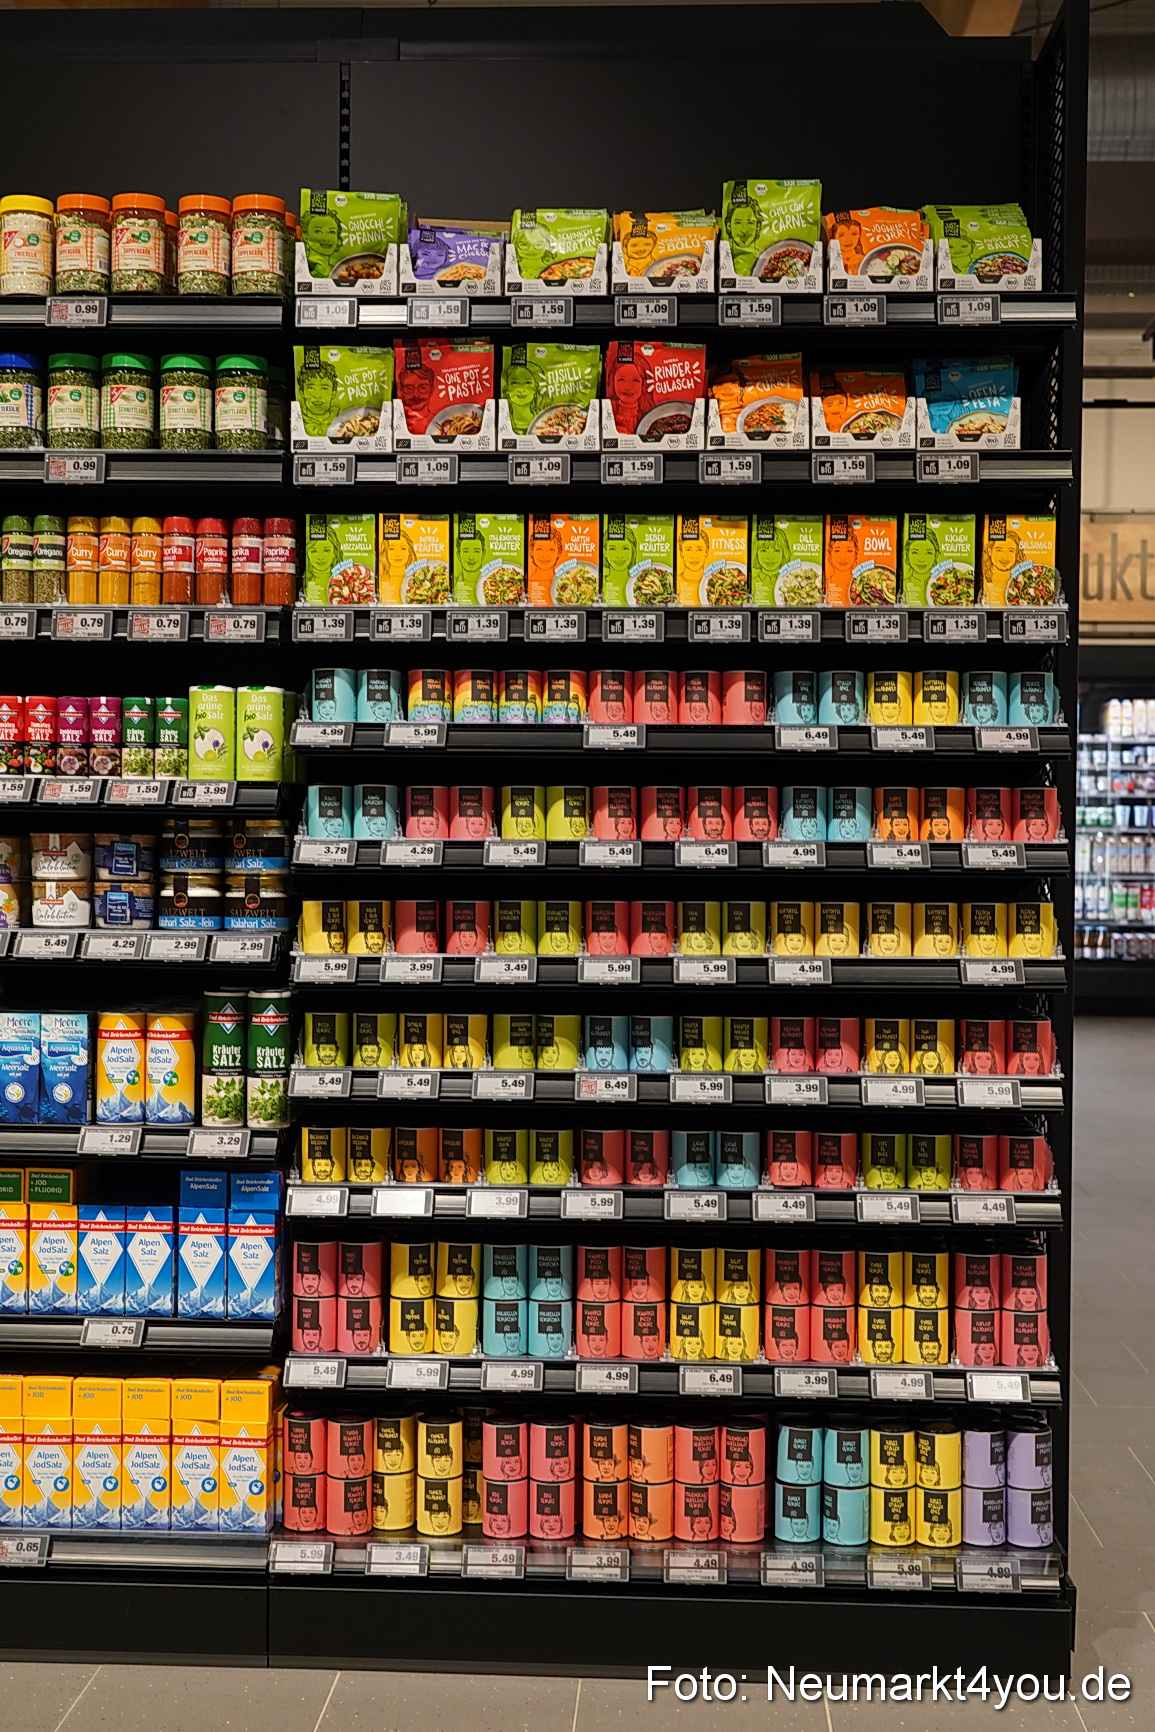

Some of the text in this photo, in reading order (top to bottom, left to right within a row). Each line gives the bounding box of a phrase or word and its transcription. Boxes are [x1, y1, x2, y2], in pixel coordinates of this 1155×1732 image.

[769, 202, 804, 217] CHILI CON
[348, 218, 384, 232] GNOCCHI
[772, 213, 806, 233] CARNE
[871, 221, 908, 233] JOGHURT
[349, 229, 386, 247] PFANNE
[558, 229, 593, 241] SCHINKEN
[877, 229, 911, 243] CURRY
[456, 243, 476, 253] MAC
[559, 238, 596, 253] GRATIN
[667, 239, 700, 250] BOLO
[987, 241, 1021, 250] SALAT
[75, 305, 98, 314] 0.99
[438, 305, 460, 315] 1.59
[645, 304, 668, 314] 1.09
[749, 304, 772, 313] 1.59
[854, 303, 877, 313] 1.09
[968, 302, 991, 312] 1.09
[654, 361, 691, 379] RINDER
[344, 370, 377, 385] ONE POT
[445, 370, 479, 385] ONE POT
[547, 367, 581, 384] FUSILLI
[655, 378, 695, 394] GULASCH
[757, 376, 791, 391] CURRY
[347, 384, 380, 401] PASTA
[448, 383, 482, 401] PASTA
[548, 382, 585, 398] PFANNE
[864, 398, 891, 409] CURRY
[972, 397, 1000, 408] FETA
[73, 461, 96, 471] 0.99
[324, 462, 346, 472] 1.59
[538, 462, 561, 471] 1.09
[631, 462, 654, 471] 1.59
[729, 461, 752, 471] 1.59
[344, 534, 367, 542] TOMATE
[570, 535, 590, 543] GARTEN
[644, 534, 666, 542] SIEBEN
[799, 534, 813, 544] DILL
[414, 543, 444, 552] KRÄUTER
[489, 541, 521, 551] KRÄUTER
[565, 542, 596, 552] KRÄUTER
[639, 542, 670, 552] KRÄUTER
[712, 537, 745, 550] FITNESS
[793, 542, 820, 551] KRÄUTER
[864, 536, 892, 552] BOWL
[942, 542, 971, 552] KRÄUTER
[1018, 538, 1053, 550] BALSAMICO
[37, 548, 63, 558] Oregano
[72, 546, 93, 560] Curry
[135, 546, 157, 560] Curry
[5, 617, 28, 627] 0.79
[157, 619, 180, 629] 0.79
[233, 620, 256, 630] 0.79
[322, 619, 345, 629] 1.39
[632, 619, 655, 629] 1.39
[719, 620, 741, 630] 1.39
[876, 620, 899, 629] 1.39
[202, 694, 217, 702] Das
[251, 694, 267, 702] Das
[198, 702, 223, 711] grüne
[247, 702, 271, 711] grüne
[31, 731, 49, 741] SALZ
[94, 733, 112, 742] SALZ
[126, 733, 145, 742] SALZ
[413, 729, 437, 737] 5.99
[613, 730, 637, 738] 5.49
[1006, 733, 1029, 741] 4.99
[70, 785, 92, 793] 1.59
[137, 786, 159, 794] 1.59
[204, 787, 227, 795] 3.99
[324, 846, 348, 855] 3.79
[410, 847, 434, 855] 4.29
[609, 848, 633, 856] 5.49
[705, 848, 728, 856] 6.49
[793, 848, 816, 857] 4.99
[992, 850, 1016, 858] 5.49
[263, 919, 277, 928] Salz
[174, 941, 197, 950] 2.99
[240, 942, 263, 951] 2.99
[324, 963, 348, 971] 5.99
[410, 963, 433, 972] 3.99
[608, 964, 631, 973] 5.99
[704, 965, 727, 973] 5.99
[799, 965, 822, 973] 4.99
[991, 966, 1015, 974] 4.99
[49, 1045, 78, 1053] Aquasale
[110, 1047, 132, 1055] Alpen
[150, 1047, 169, 1056] Alpen
[212, 1044, 240, 1057] Kräuter
[256, 1046, 285, 1057] Kräuter
[106, 1055, 135, 1064] JodSalz
[212, 1055, 240, 1067] SALZ
[256, 1056, 285, 1068] SALZ
[50, 1064, 77, 1072] Meersalz
[319, 1077, 342, 1086] 5.49
[502, 1080, 525, 1088] 5.49
[605, 1081, 628, 1090] 6.49
[700, 1082, 723, 1091] 5.99
[796, 1084, 819, 1093] 3.99
[892, 1085, 915, 1094] 4.99
[988, 1087, 1011, 1096] 5.99
[110, 1134, 132, 1144] 1.29
[217, 1137, 241, 1146] 3.29
[496, 1197, 519, 1206] 3.99
[591, 1198, 614, 1207] 5.99
[782, 1201, 806, 1210] 4.49
[887, 1202, 910, 1211] 5.49
[982, 1203, 1006, 1212] 4.49
[42, 1237, 65, 1246] Alpen
[91, 1238, 112, 1247] Alpen
[191, 1241, 213, 1249] Alpen
[38, 1245, 68, 1254] JodSalz
[93, 1247, 109, 1255] Salz
[193, 1249, 209, 1257] Salz
[112, 1326, 135, 1335] 0.75
[314, 1366, 337, 1376] 5.49
[511, 1370, 534, 1379] 4.99
[606, 1372, 629, 1381] 4.99
[710, 1374, 733, 1383] 6.49
[805, 1376, 828, 1385] 3.99
[901, 1378, 924, 1388] 4.99
[37, 1452, 60, 1460] Alpen
[232, 1455, 255, 1463] Alpen
[33, 1461, 63, 1469] JodSalz
[228, 1464, 257, 1472] JodSalz
[492, 1554, 515, 1564] 5.49
[595, 1556, 621, 1569] 3.99
